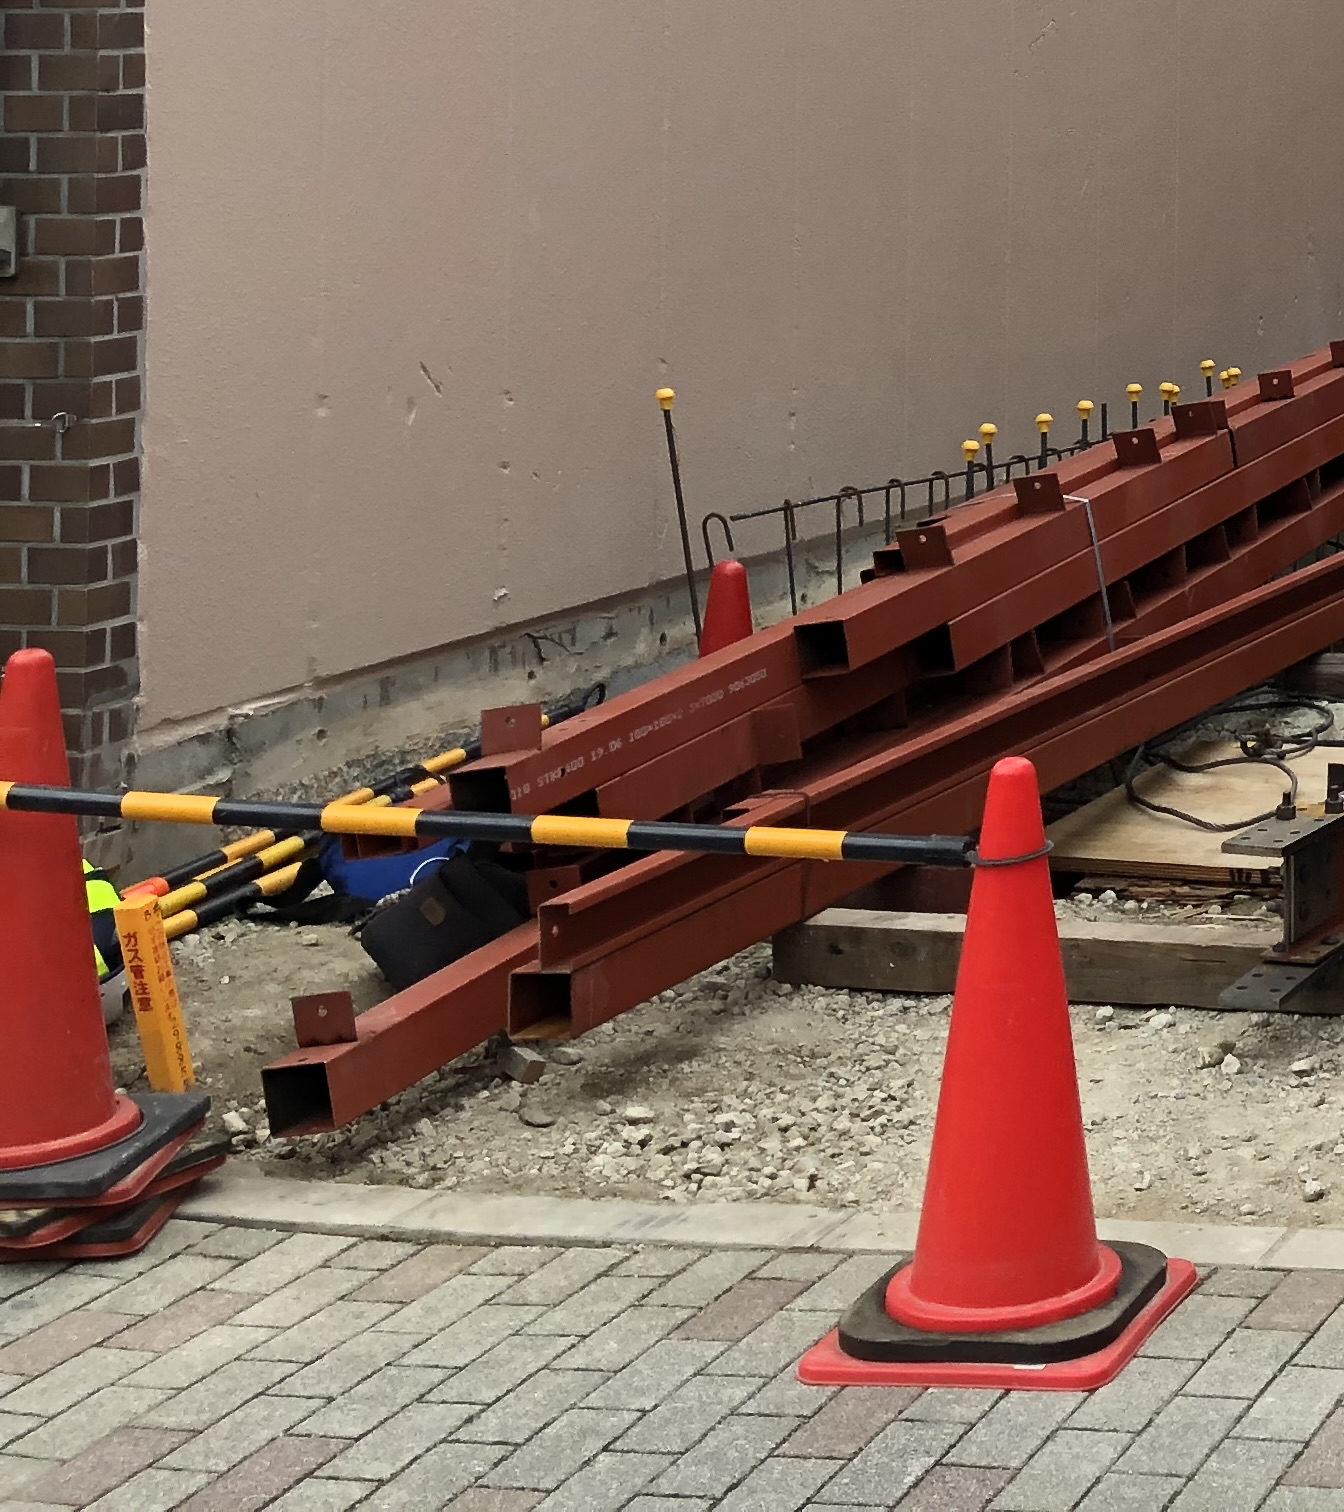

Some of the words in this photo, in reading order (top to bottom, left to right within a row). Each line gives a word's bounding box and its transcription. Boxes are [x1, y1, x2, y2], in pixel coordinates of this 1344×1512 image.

[123, 931, 153, 1012] ガス管注意
